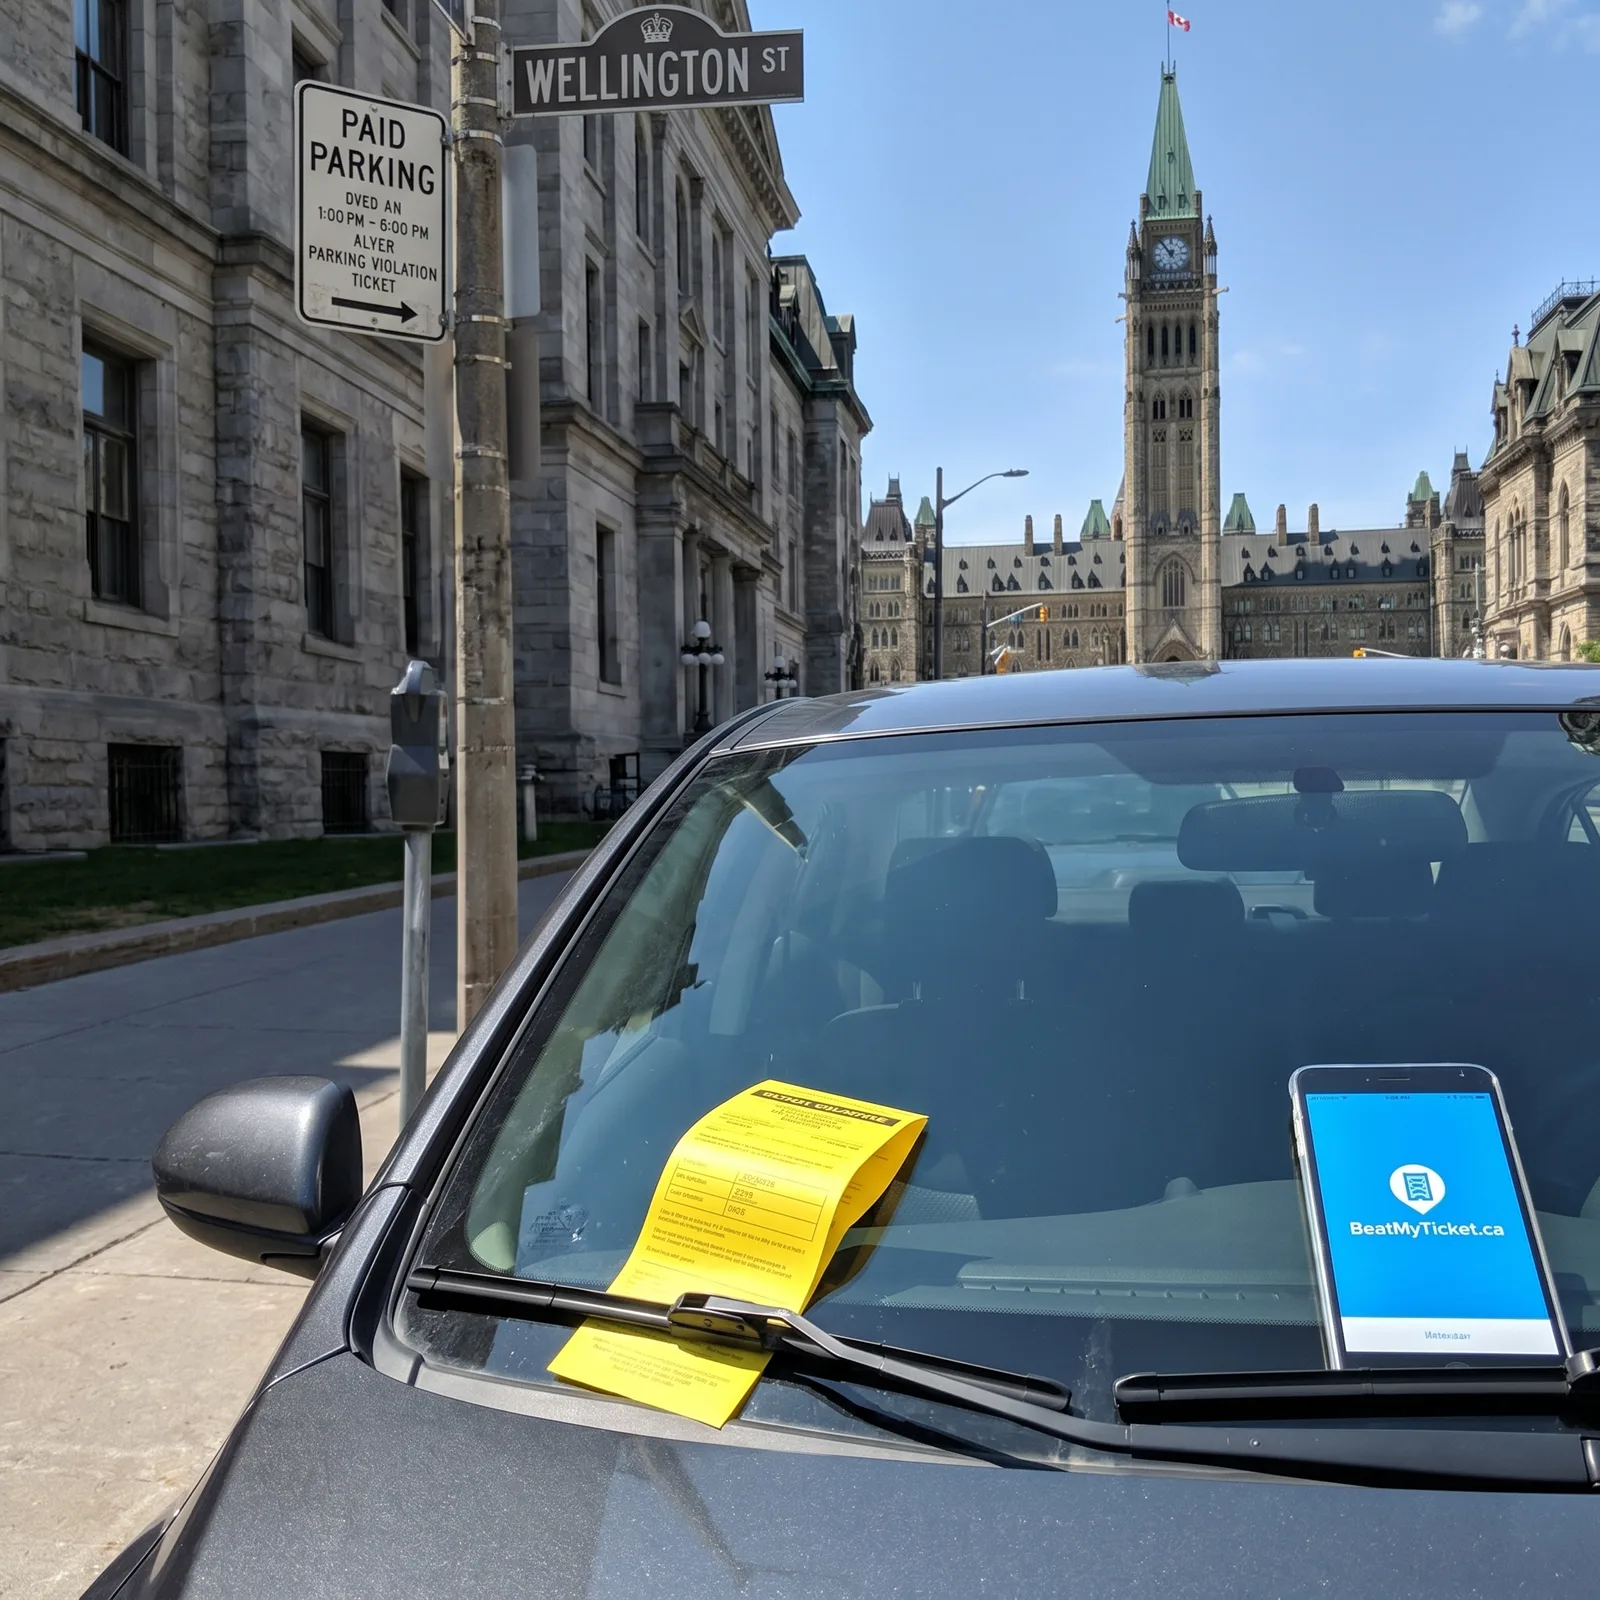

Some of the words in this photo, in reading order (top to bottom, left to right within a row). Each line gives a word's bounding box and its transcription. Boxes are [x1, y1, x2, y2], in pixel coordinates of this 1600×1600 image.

[525, 47, 750, 104] WELLINGTON
[761, 46, 790, 74] ST
[342, 108, 406, 150] PAID
[310, 140, 435, 196] PARKING
[345, 191, 379, 210] DVED
[384, 200, 402, 215] AN
[318, 206, 344, 224] 1:00
[346, 212, 365, 228] PM
[379, 218, 408, 236] 6:00
[411, 224, 429, 240] PM
[353, 233, 395, 254] ALYER
[308, 245, 366, 269] PARKING
[371, 256, 438, 282] VIOLATION
[352, 272, 396, 294] TICKET
[1349, 1220, 1505, 1239] BeatMyTicket.ca
